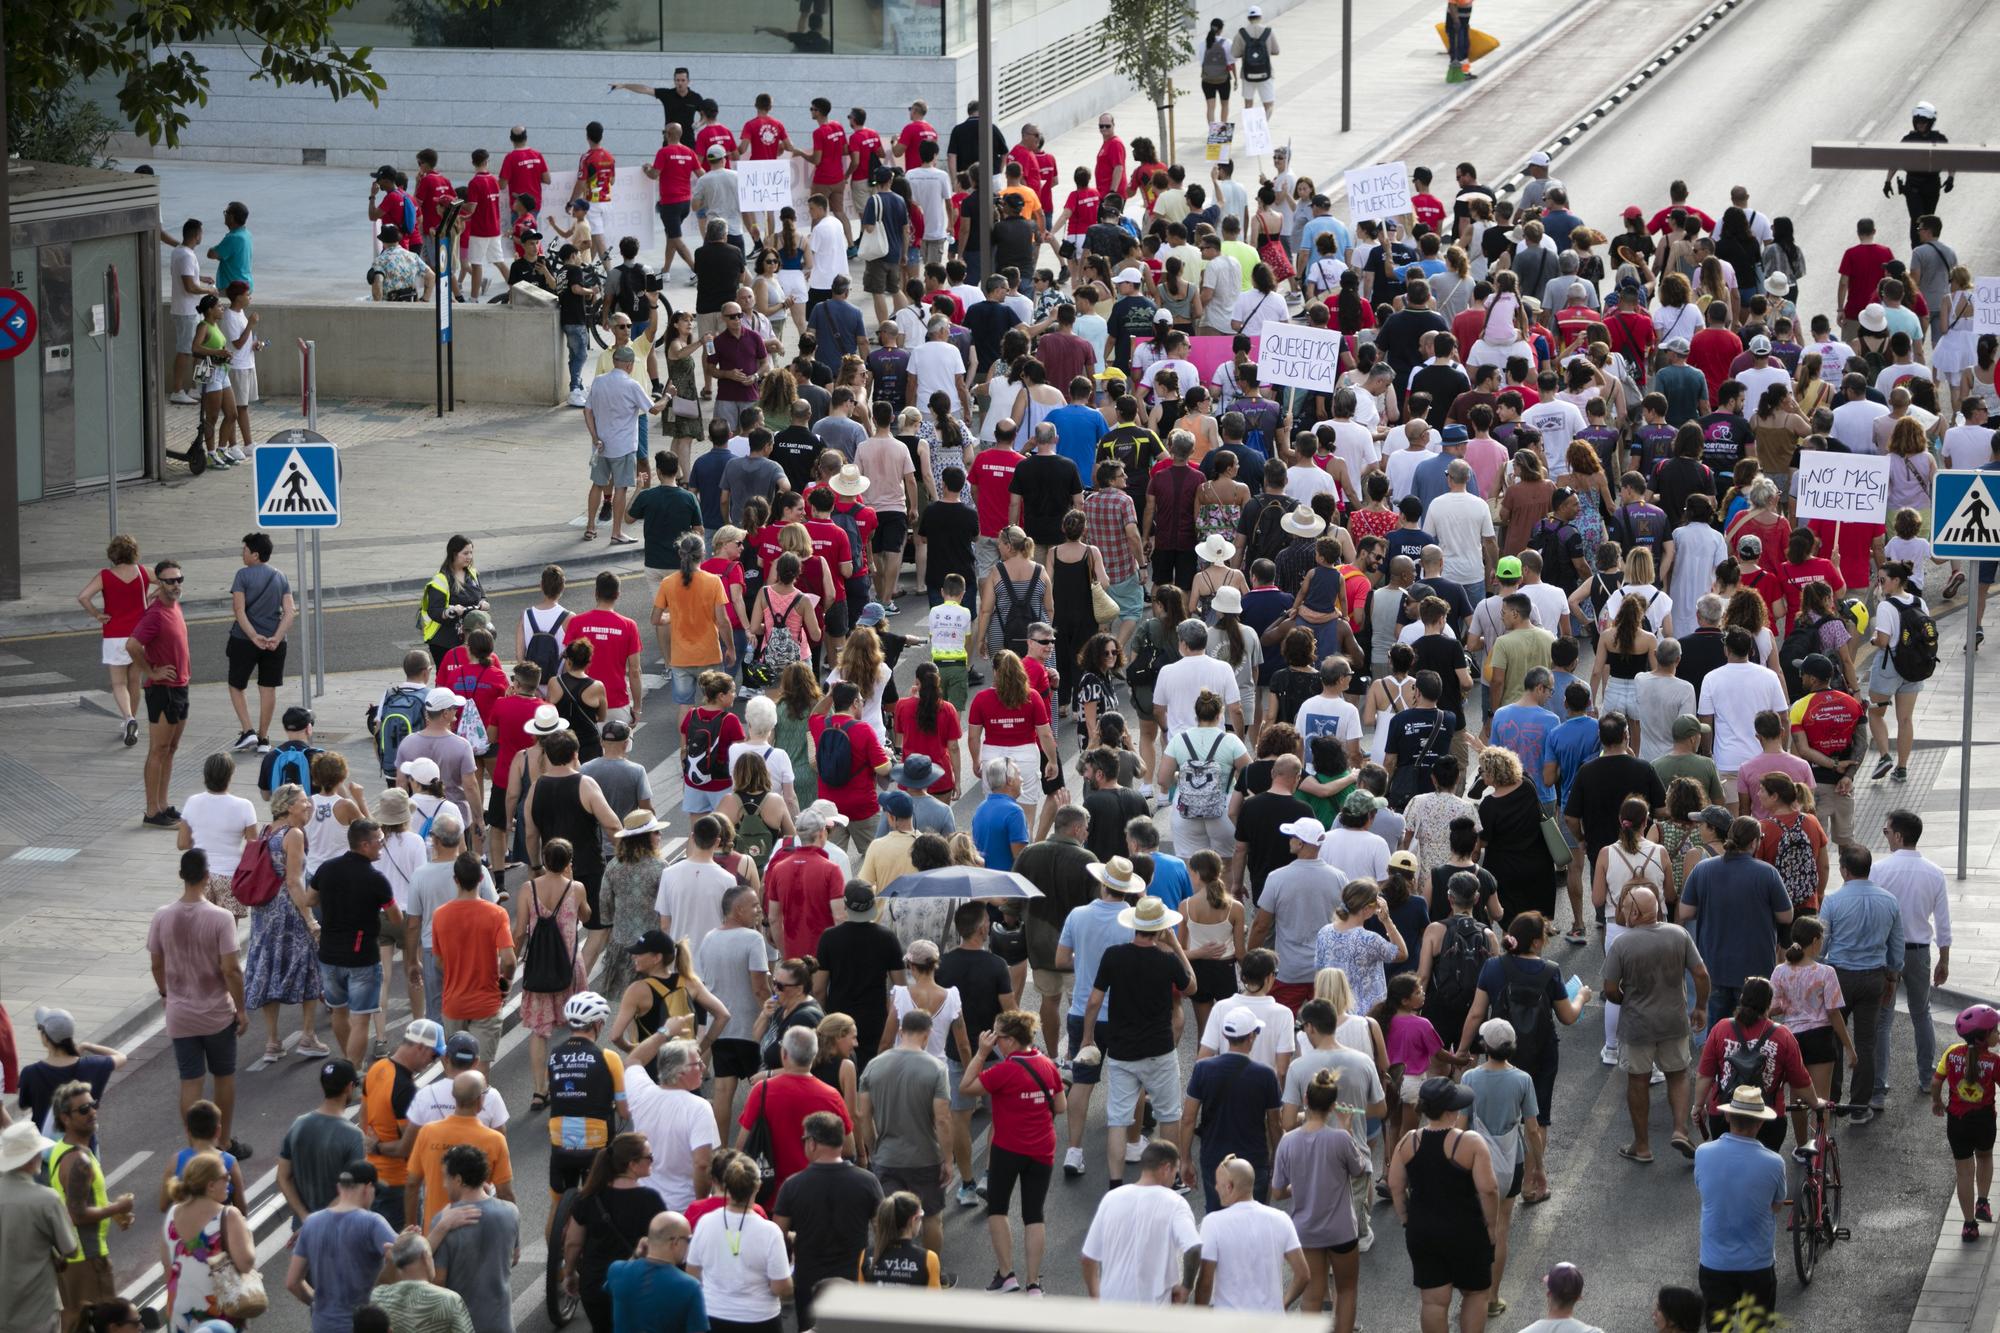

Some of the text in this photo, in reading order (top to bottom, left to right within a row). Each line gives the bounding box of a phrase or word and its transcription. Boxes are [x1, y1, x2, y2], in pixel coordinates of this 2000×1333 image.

[1352, 172, 1400, 196] NO MAS
[1357, 191, 1406, 213] MUERTES
[1266, 335, 1337, 361] QUEREMOS
[1808, 467, 1837, 484] NO
[1844, 469, 1882, 490] MAS
[1805, 490, 1880, 511] MUERTES
[562, 1052, 596, 1063] vida
[885, 1258, 918, 1272] vida
[891, 1270, 912, 1278] Antoni
